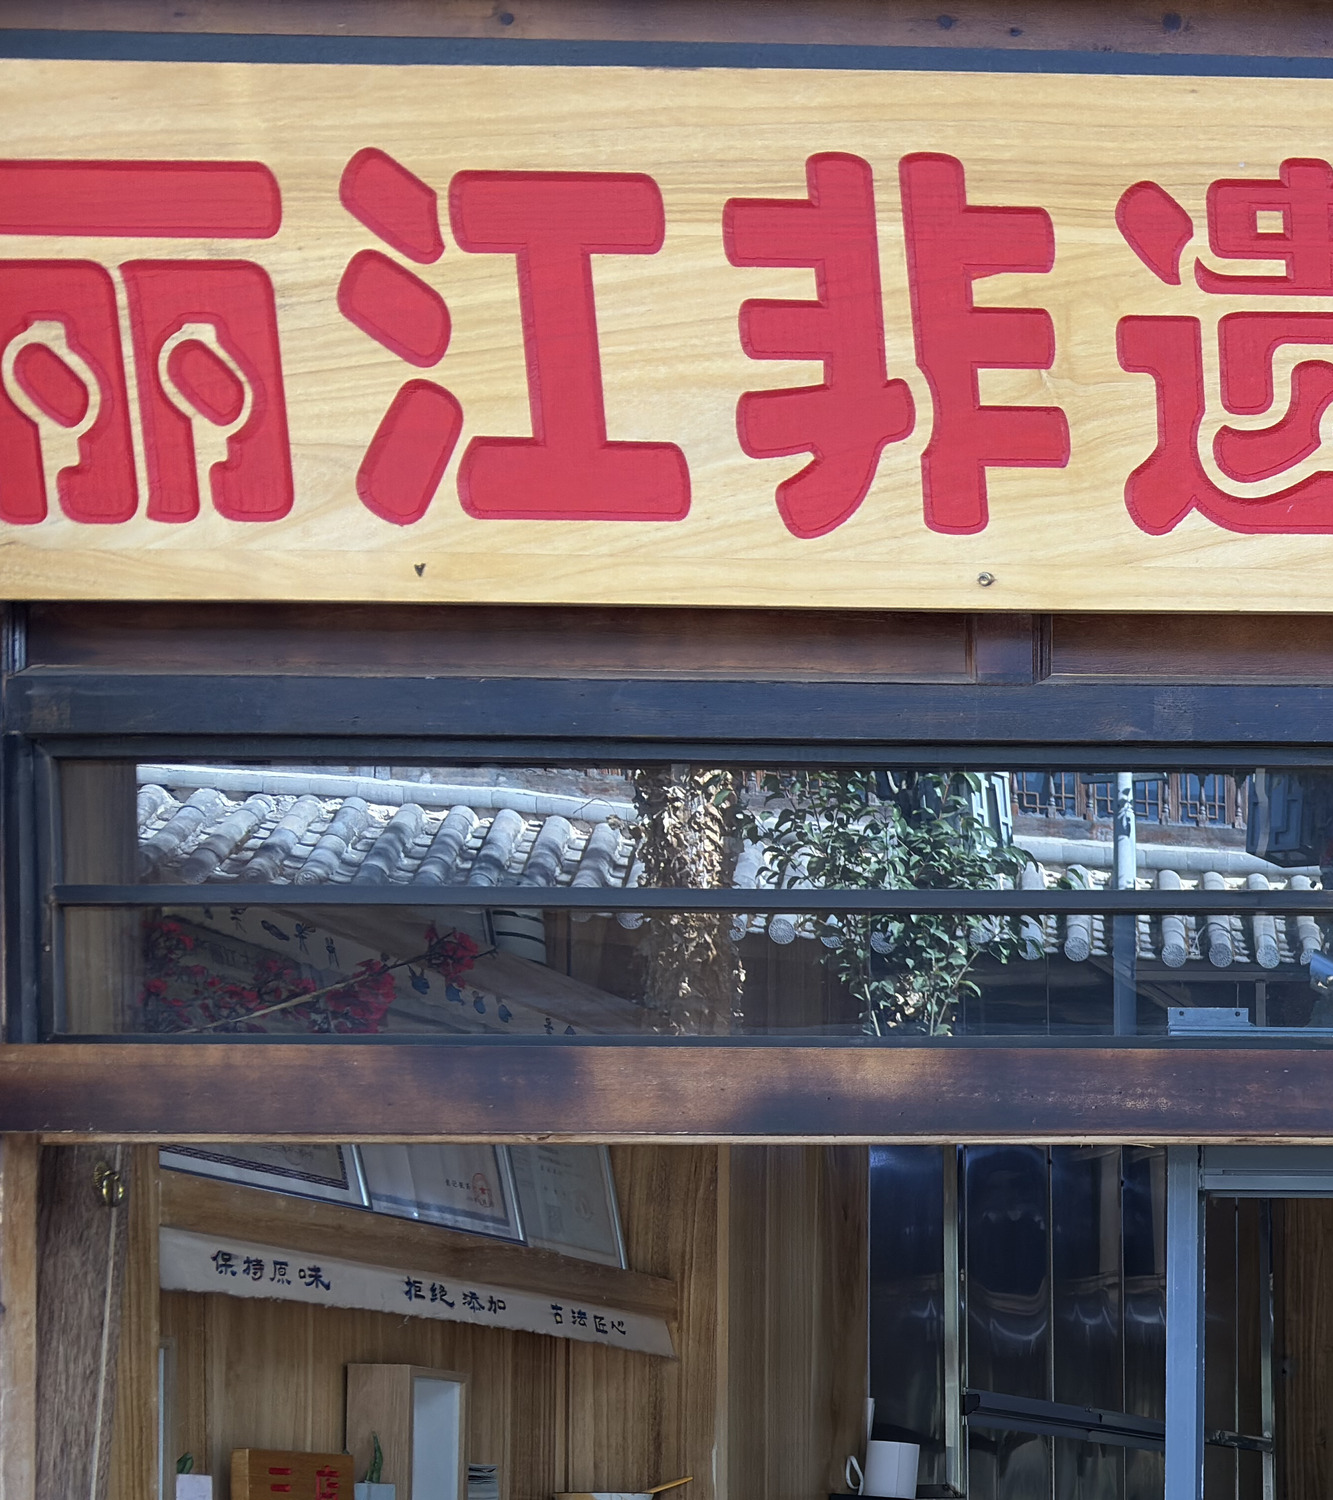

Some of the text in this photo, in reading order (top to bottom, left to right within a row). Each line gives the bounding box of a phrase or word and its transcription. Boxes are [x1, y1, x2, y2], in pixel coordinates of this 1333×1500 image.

[210, 1250, 627, 1337] 保持原味 拒绝添加 古法匠心
